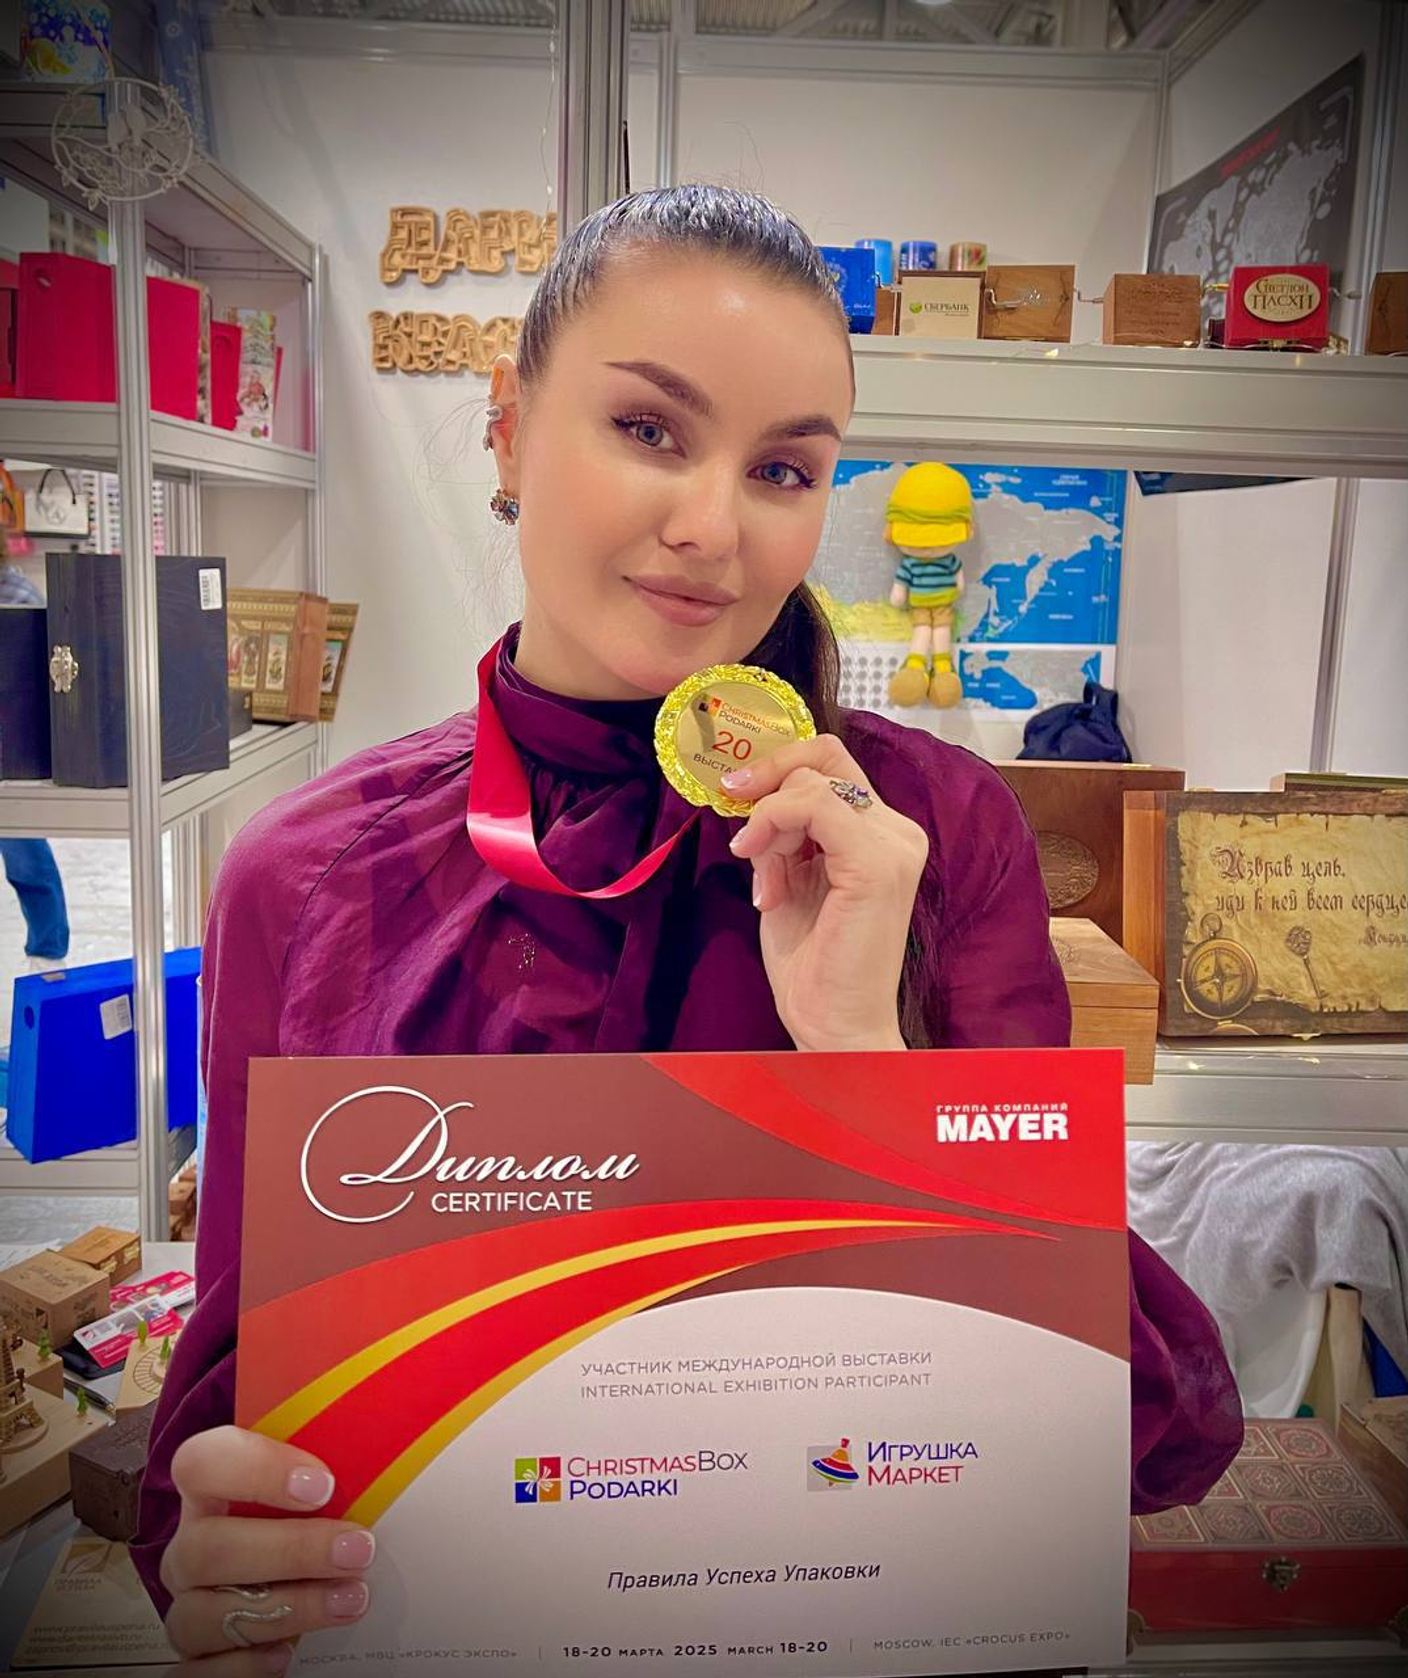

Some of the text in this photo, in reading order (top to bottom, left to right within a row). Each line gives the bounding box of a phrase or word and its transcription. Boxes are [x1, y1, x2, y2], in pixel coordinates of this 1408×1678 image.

[1252, 294, 1314, 310] ПАСХИ
[368, 311, 524, 374] КРАС
[718, 710, 763, 734] PODARKI
[712, 731, 752, 760] 20
[693, 753, 738, 774] ВЫСТА
[1216, 893, 1245, 919] иди
[1254, 886, 1263, 911] к
[1271, 889, 1298, 911] ней
[1351, 892, 1408, 919] сердце
[936, 1101, 1069, 1114] ГРУППА КОМПАНИЙ
[936, 1112, 1069, 1143] MAYER
[300, 1085, 641, 1224] Диплом
[431, 1191, 593, 1213] CERTIFICATE
[580, 1351, 932, 1377] УЧАСТНИК МЕЖДУНАРОДНОЙ ВЫСТАВКИ
[580, 1373, 932, 1399] INTERNATIONAL EXHIBITION PARTICIPANT
[867, 1441, 979, 1463] ИГРУШКА
[867, 1464, 965, 1487] МАРКЕТ
[568, 1477, 679, 1501] PODARKI
[606, 1562, 881, 1591] Правила Успеха Упаковки
[562, 1641, 829, 1658] 18-20 МАРТА 2025 MARCH 18-20
[939, 1636, 961, 1648] IEC
